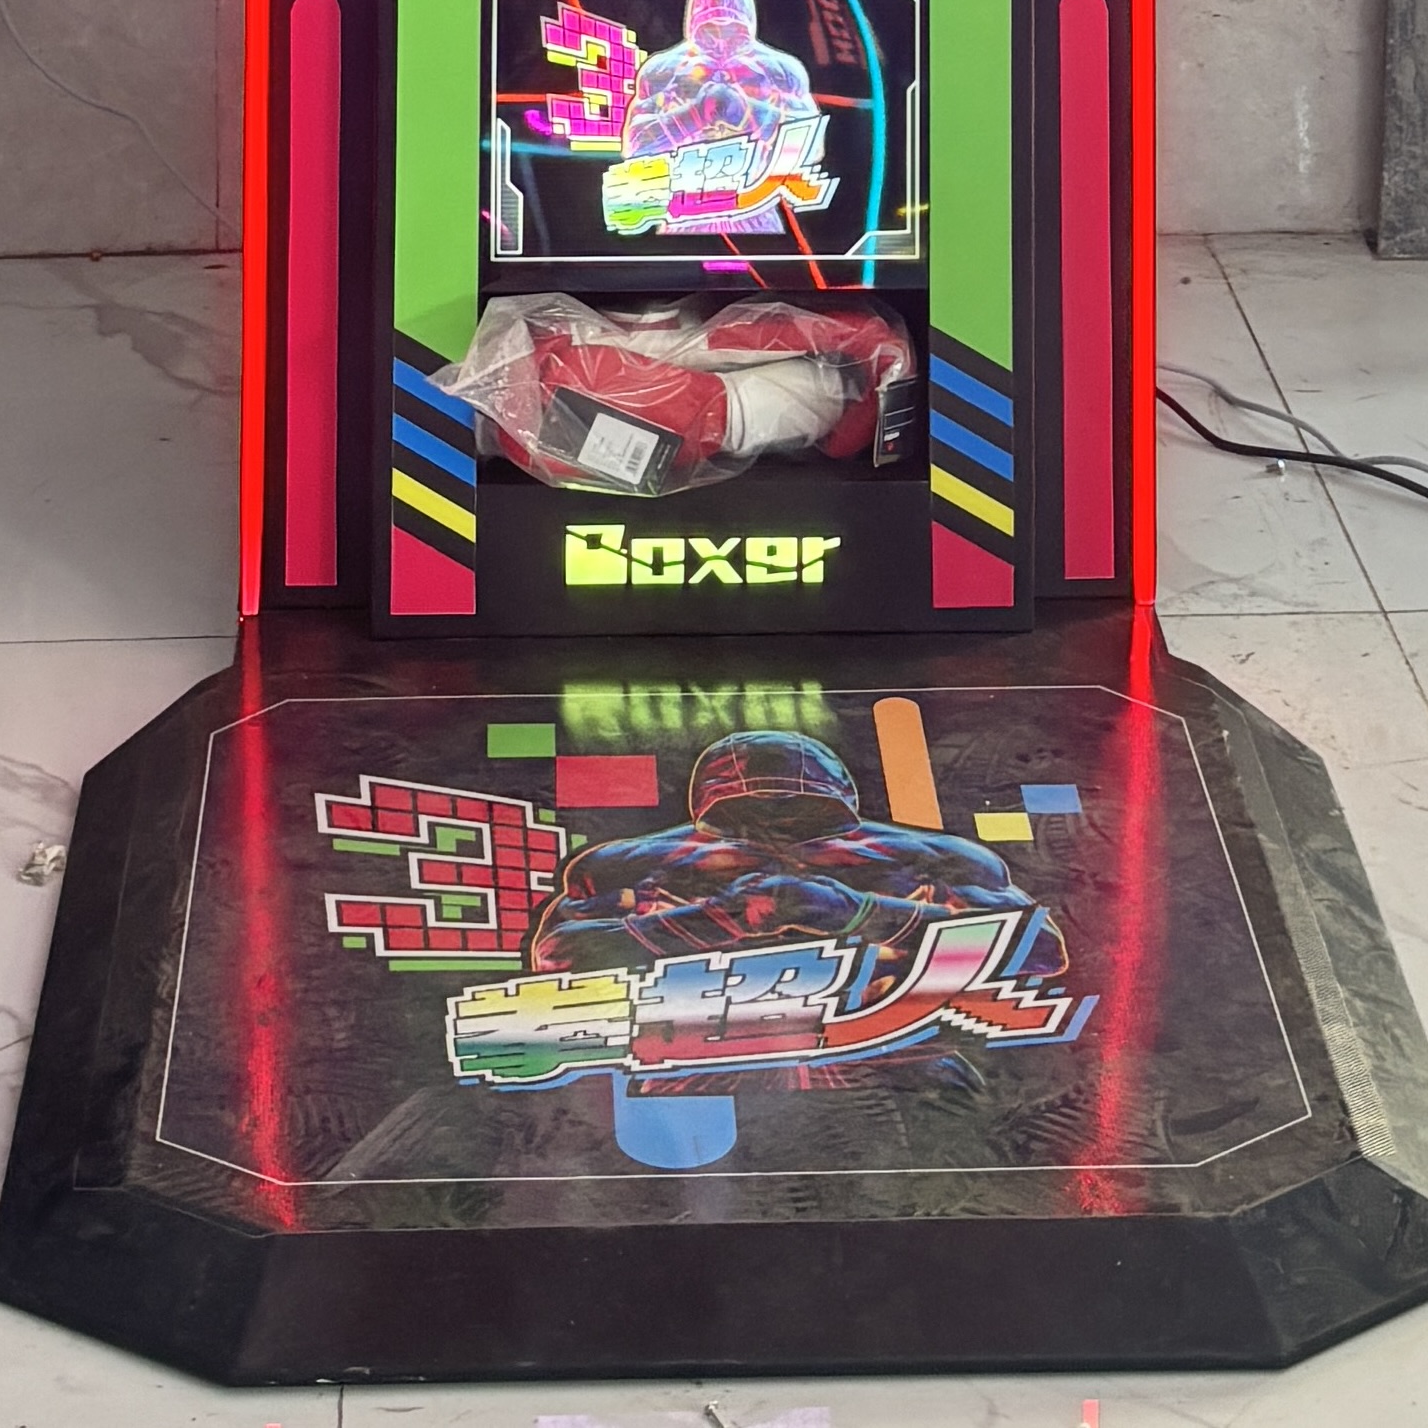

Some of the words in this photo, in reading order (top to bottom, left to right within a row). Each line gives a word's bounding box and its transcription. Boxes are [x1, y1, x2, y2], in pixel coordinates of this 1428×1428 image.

[564, 523, 841, 586] Boxer
[446, 906, 1074, 1084] 拳超人
